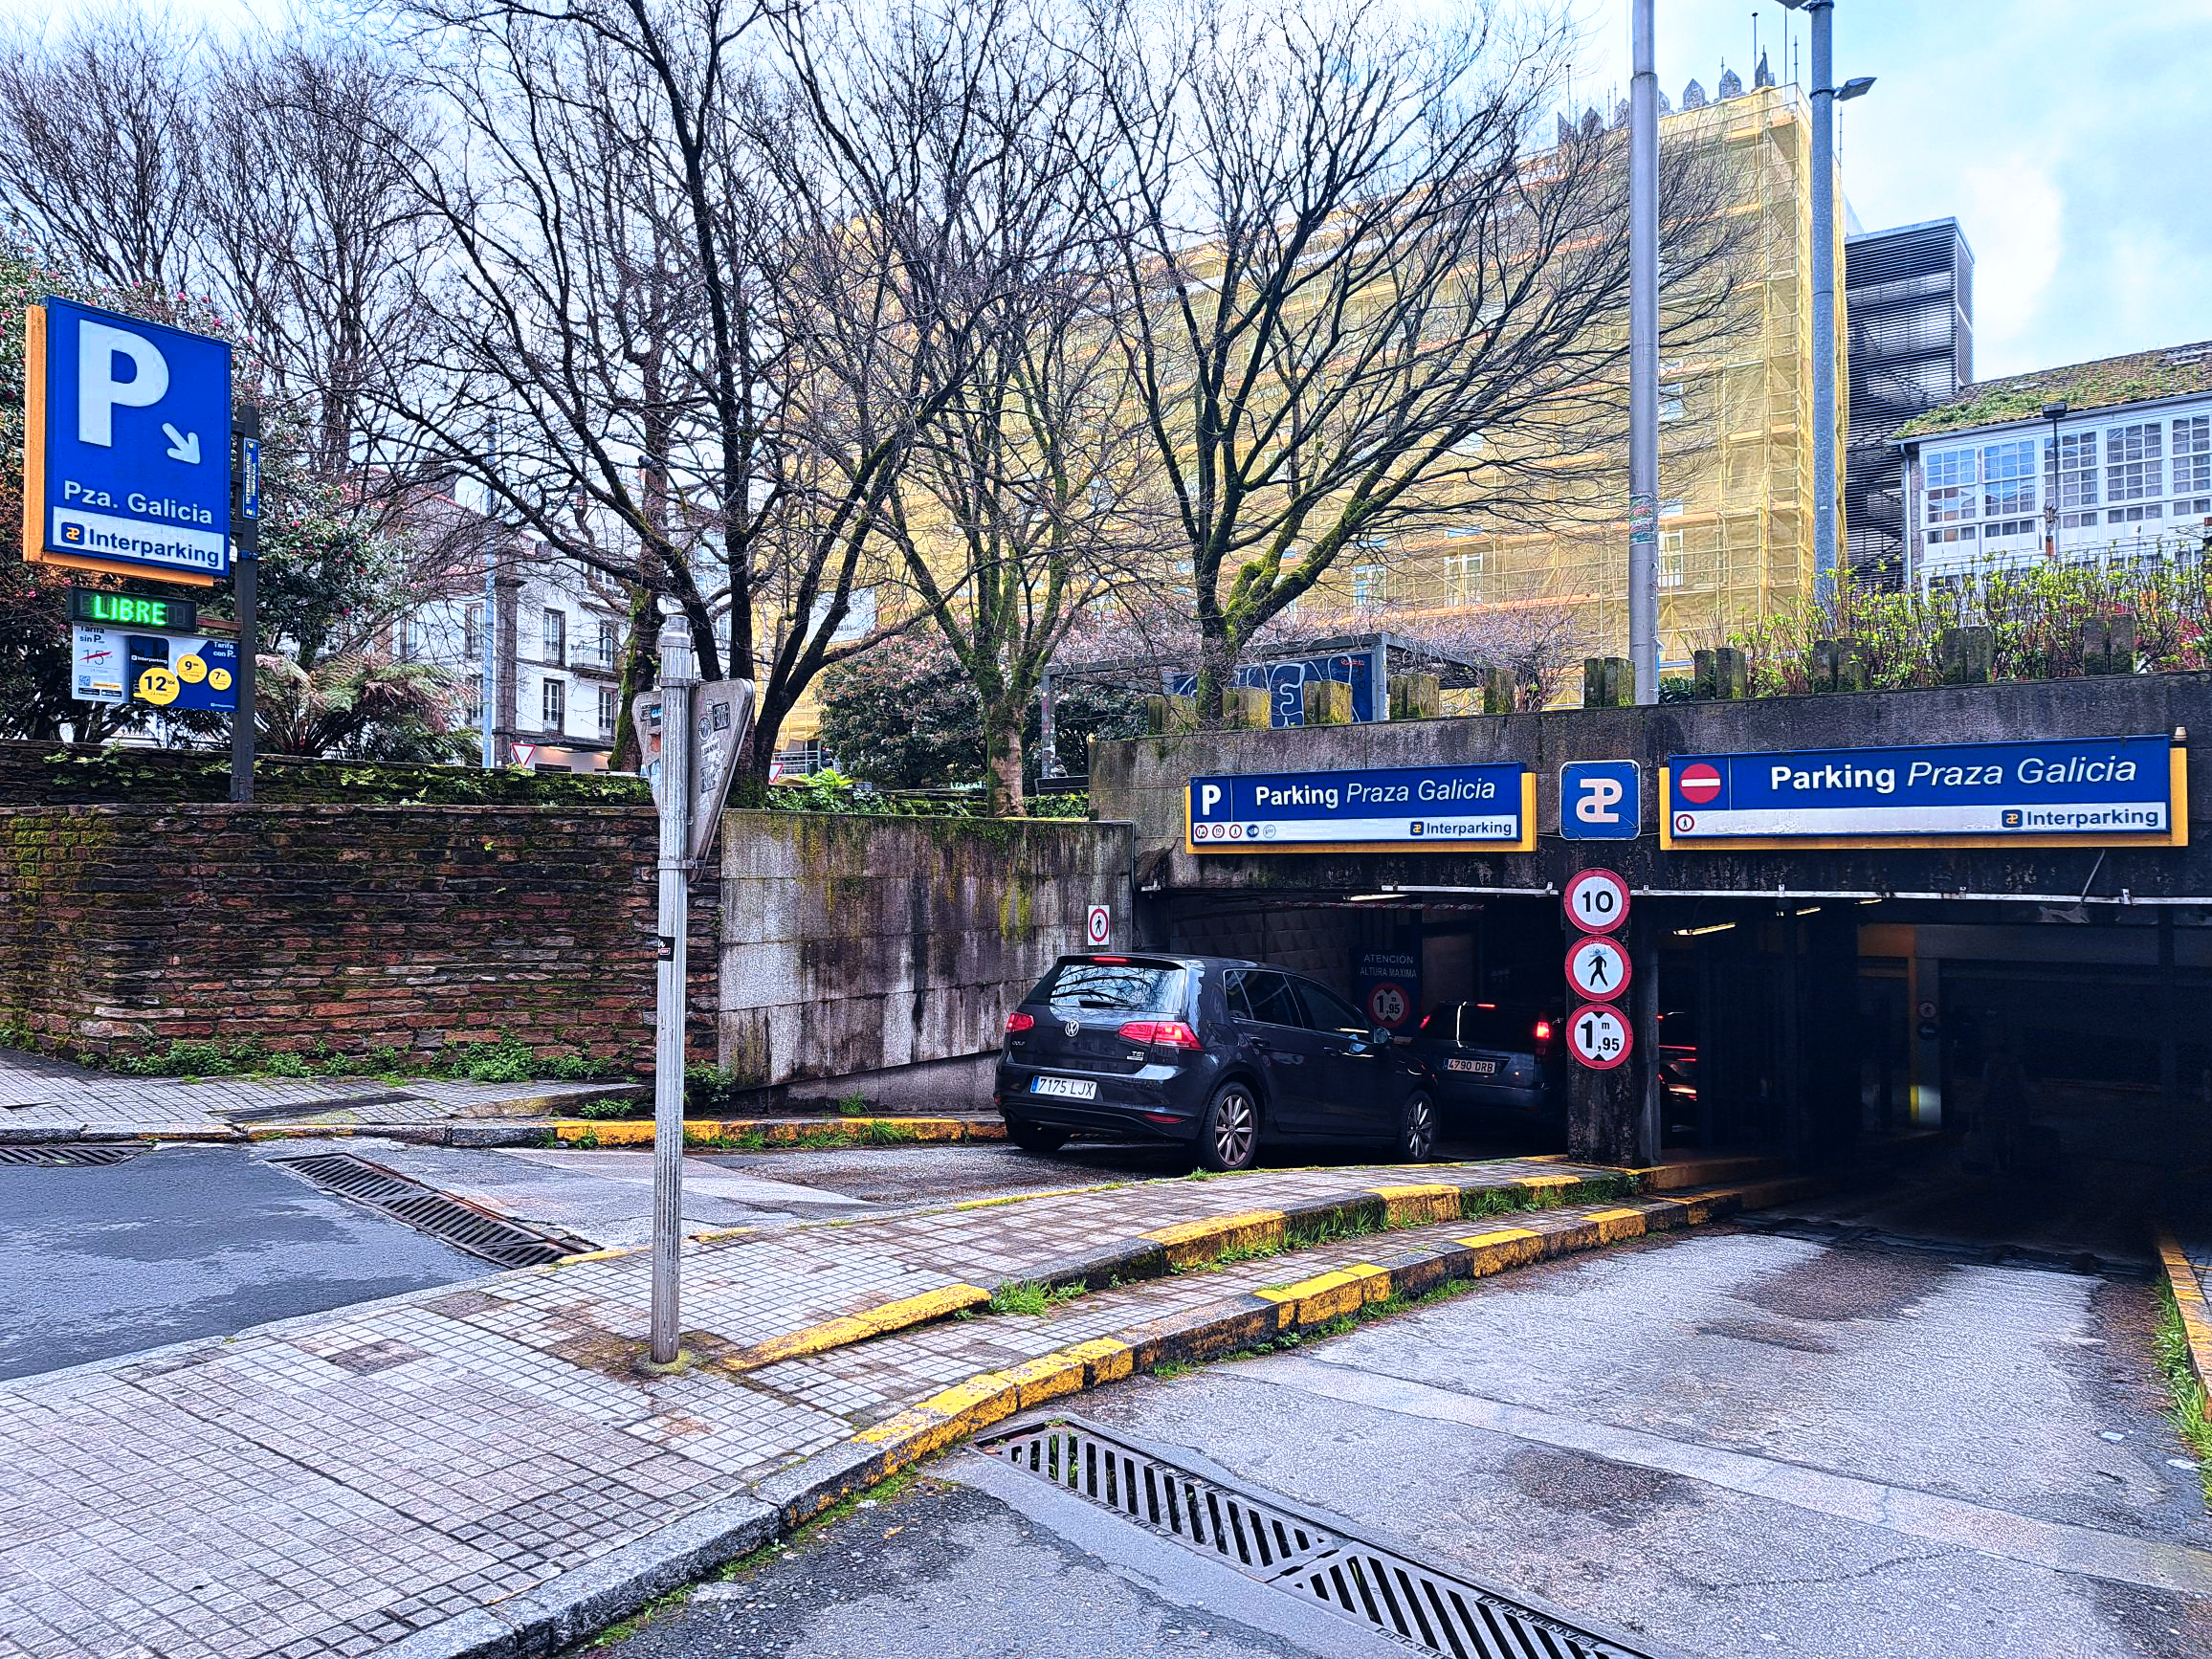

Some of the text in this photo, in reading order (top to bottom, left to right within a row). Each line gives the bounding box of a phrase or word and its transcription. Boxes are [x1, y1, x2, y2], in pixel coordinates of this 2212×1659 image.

[78, 319, 169, 447] P
[64, 480, 212, 524] Pza. Galicia
[90, 529, 219, 567] Interparking
[93, 594, 168, 626] LIBRE
[213, 641, 234, 650] Tarifa
[185, 660, 192, 671] 9
[213, 671, 221, 680] 7
[144, 675, 167, 692] 12
[1770, 757, 2136, 793] Parking Praza Galicia
[1202, 785, 1221, 815] P
[1255, 778, 1495, 808] Parking Praza Galicia
[2026, 807, 2159, 828] Interparking
[1427, 820, 1513, 837] Interparking
[1582, 891, 1614, 913] 10
[1360, 966, 1387, 978] ALTURA
[1580, 1020, 1620, 1051] 1,95
[1448, 1059, 1493, 1073] 4790 DRB
[1038, 1079, 1095, 1097] 7175 LJX
